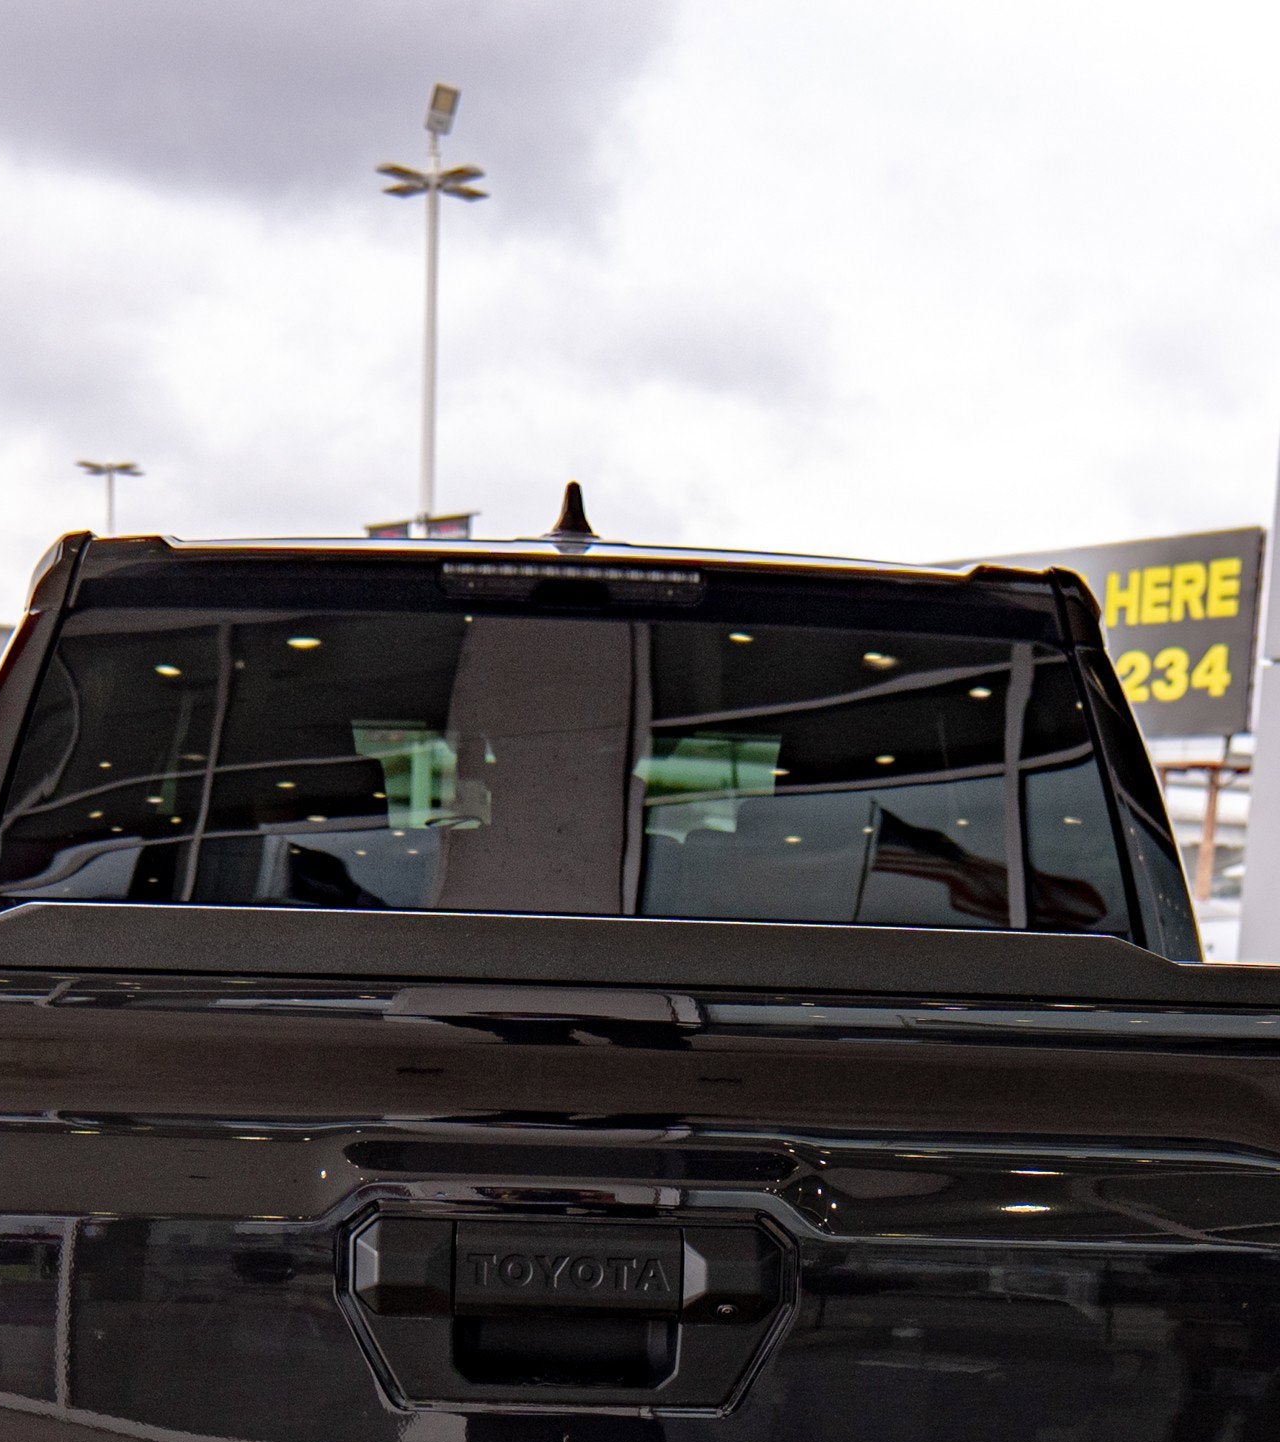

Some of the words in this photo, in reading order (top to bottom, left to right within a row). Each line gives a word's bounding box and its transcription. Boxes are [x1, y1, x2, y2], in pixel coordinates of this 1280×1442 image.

[1105, 557, 1242, 628] HERE
[1114, 644, 1231, 702] 234
[466, 1252, 671, 1292] TOYOTA
